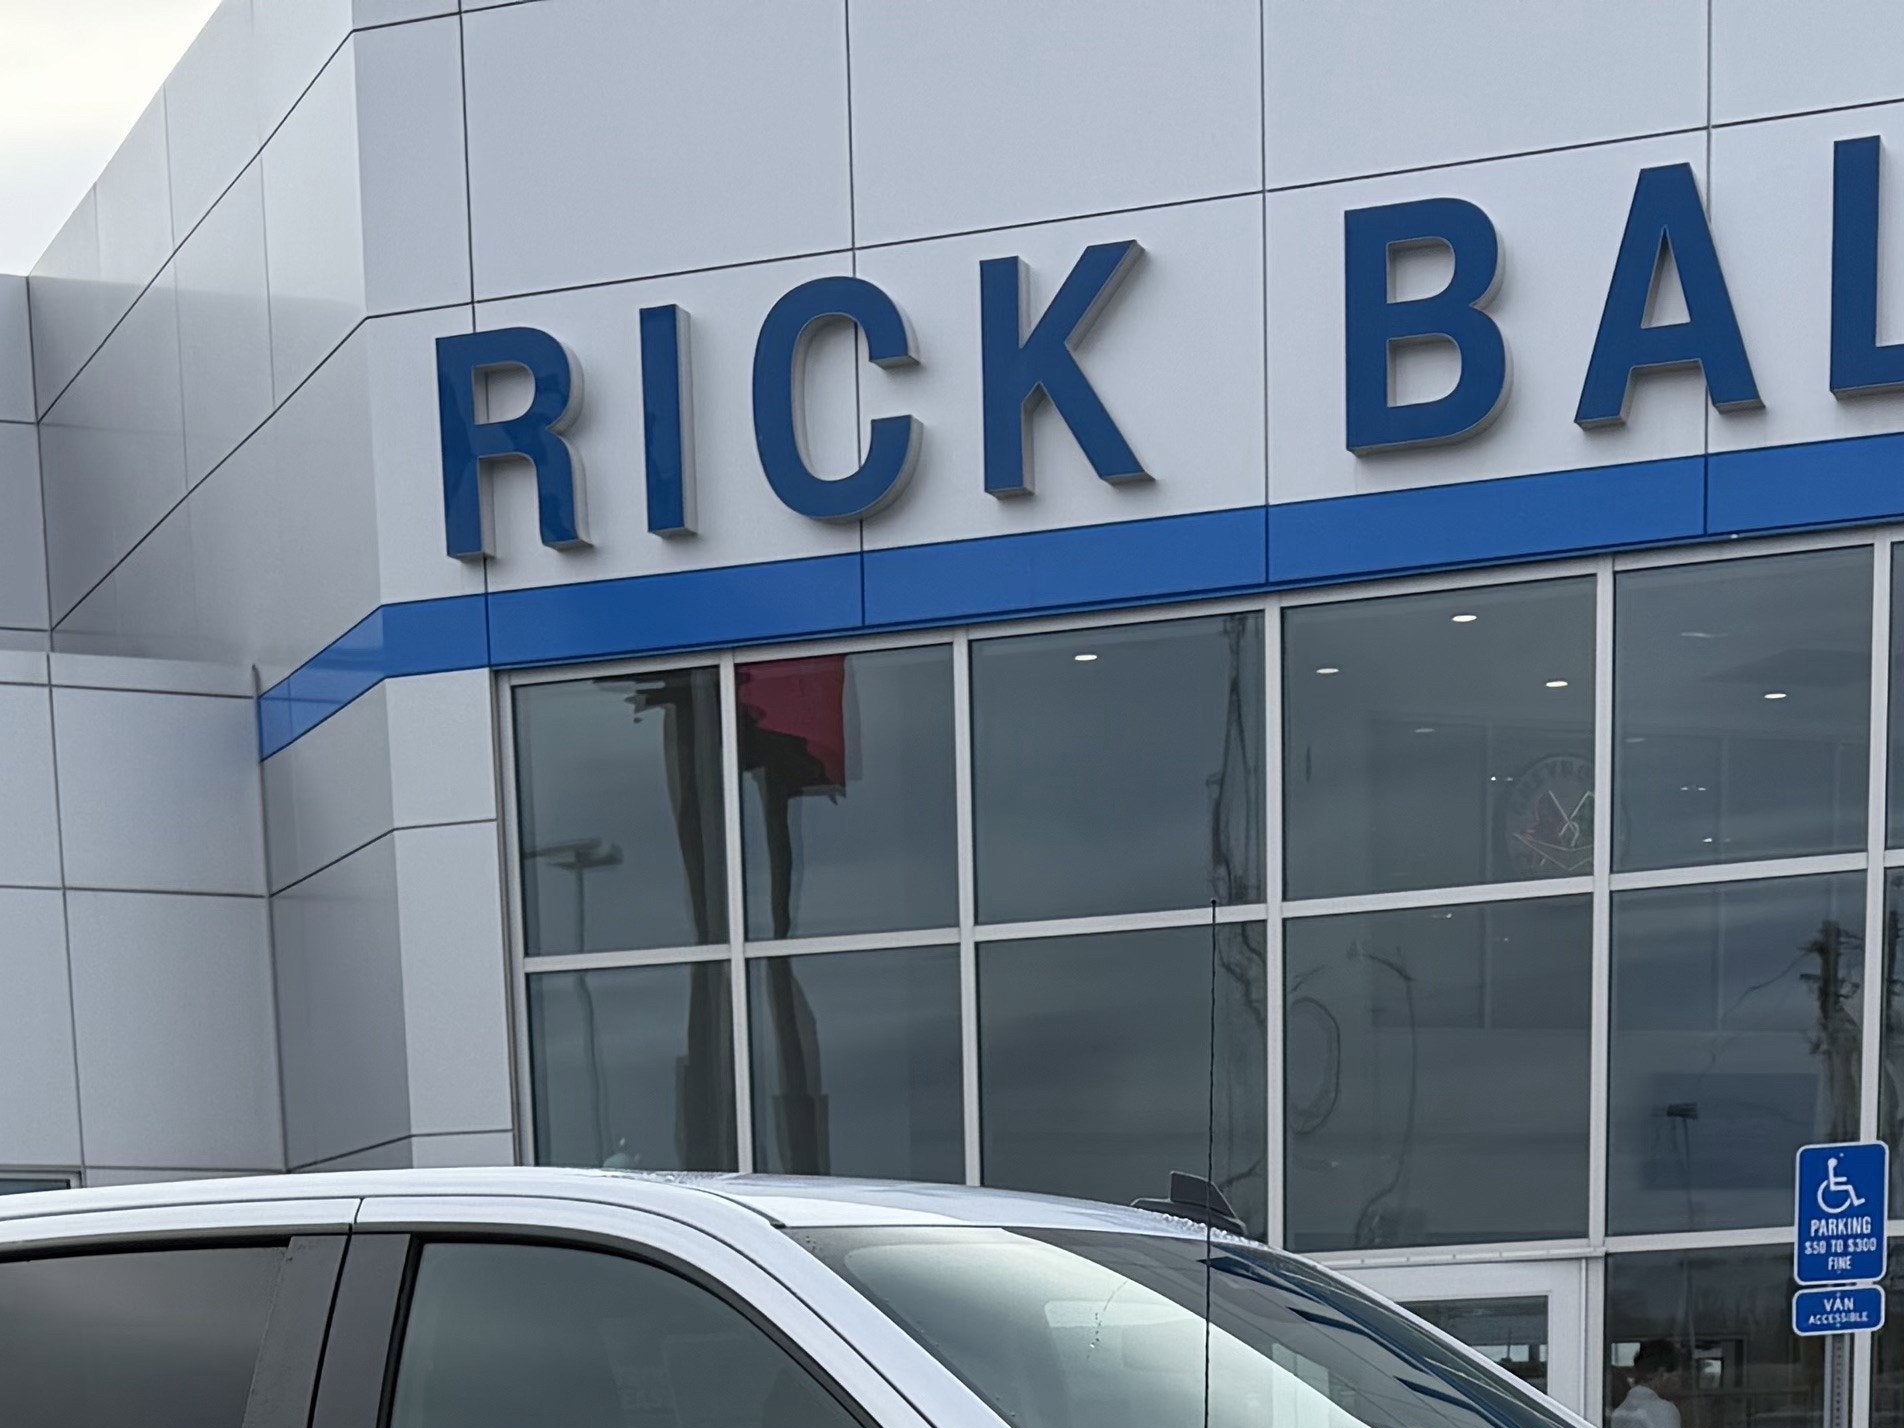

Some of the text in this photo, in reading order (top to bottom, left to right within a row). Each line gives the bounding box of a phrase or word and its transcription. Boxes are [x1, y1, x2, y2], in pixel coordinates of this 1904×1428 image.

[435, 239, 1152, 561] RICK
[1810, 1216, 1871, 1236] PARKING
[1804, 1238, 1877, 1254] $50 TO $300
[1828, 1255, 1852, 1270] FINE
[1823, 1297, 1854, 1311] VAN
[1808, 1312, 1869, 1325] ACCESSIBLE
